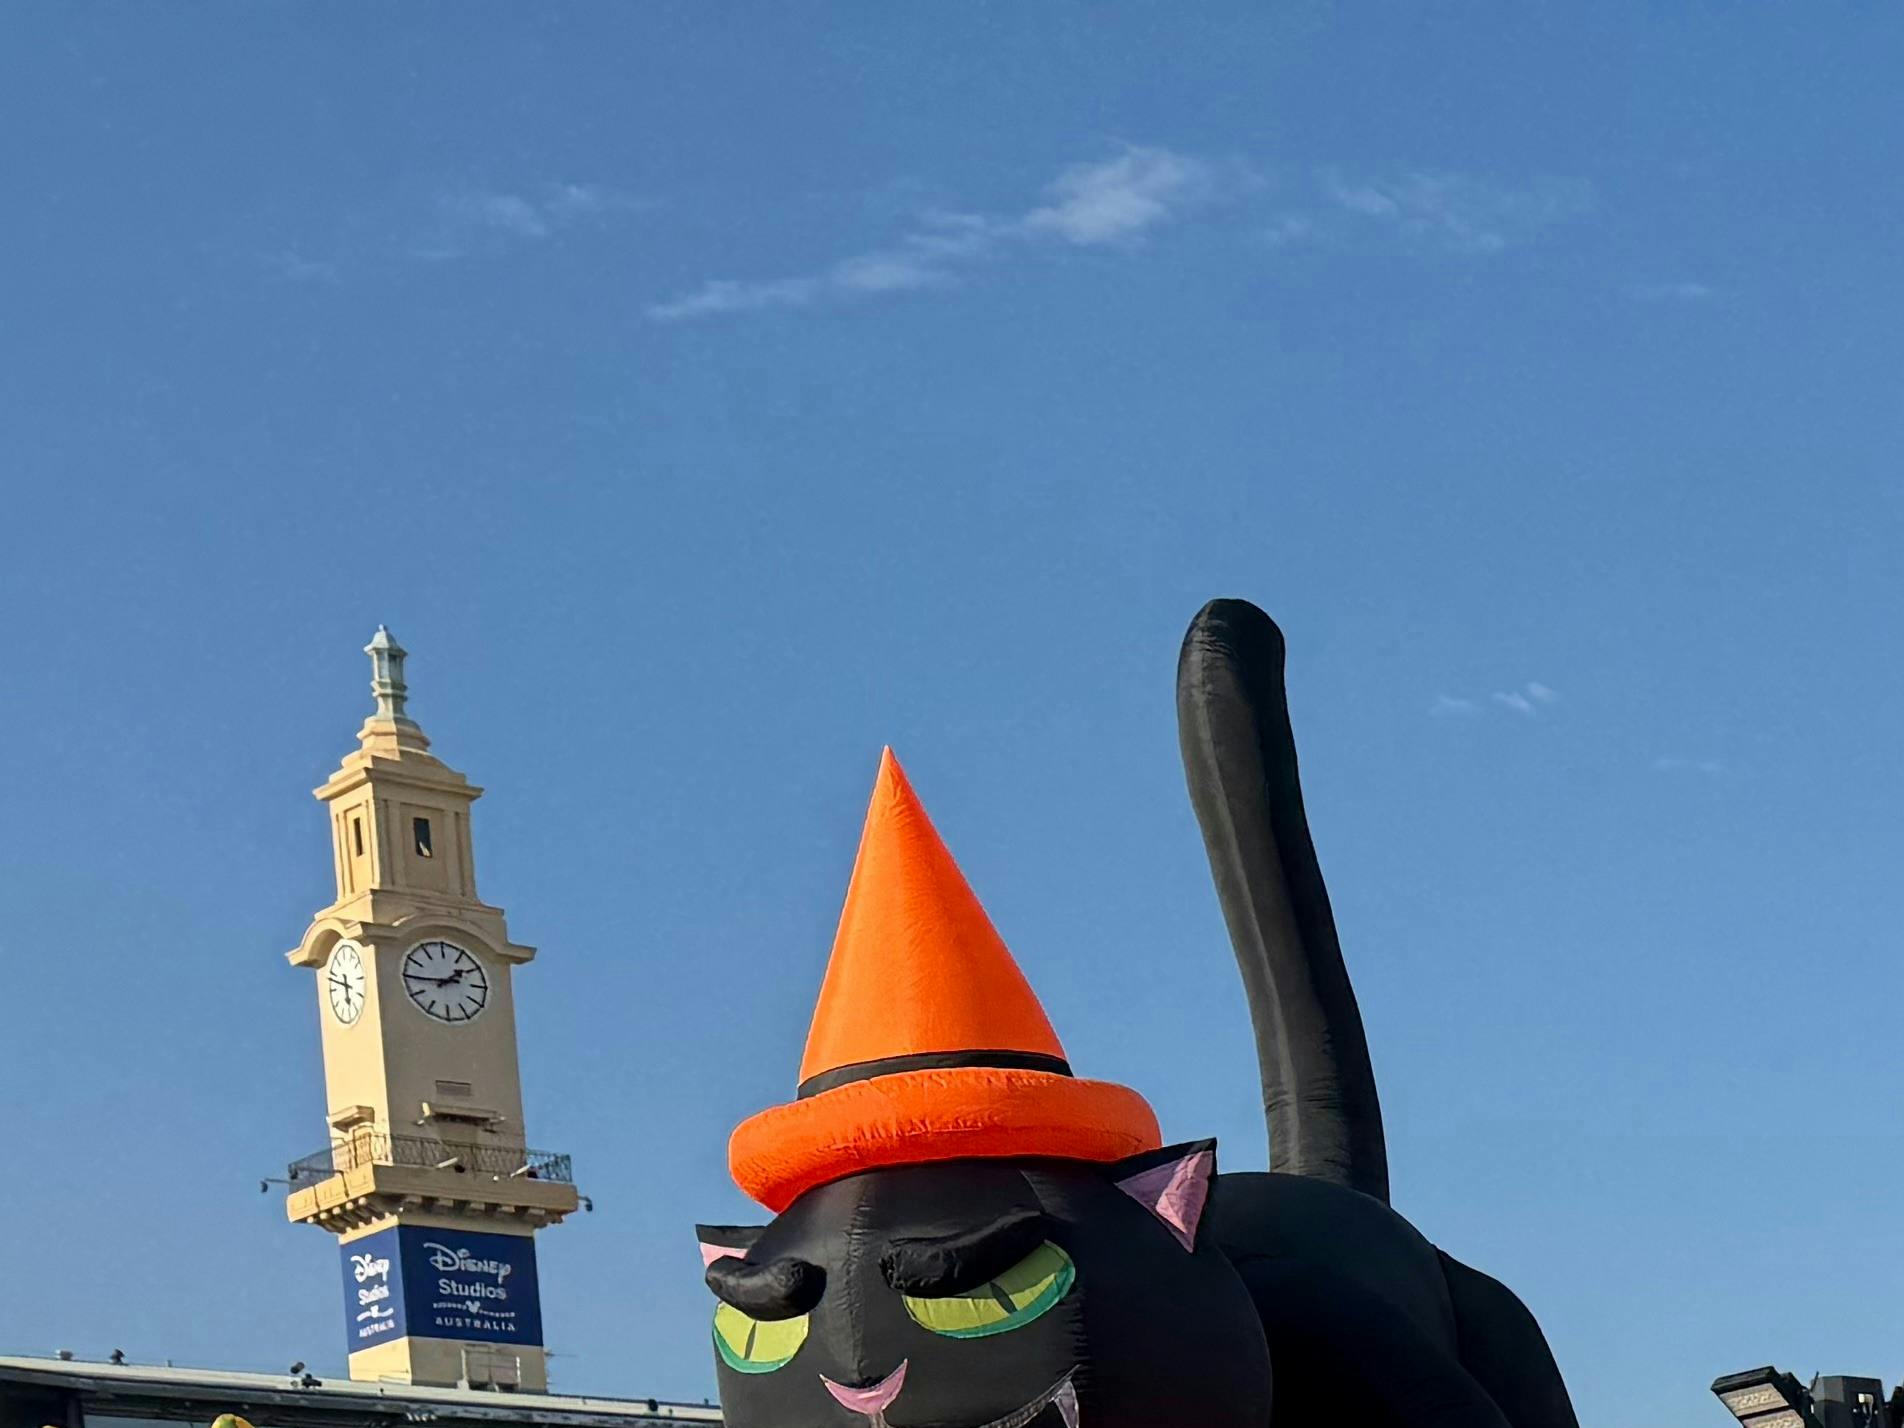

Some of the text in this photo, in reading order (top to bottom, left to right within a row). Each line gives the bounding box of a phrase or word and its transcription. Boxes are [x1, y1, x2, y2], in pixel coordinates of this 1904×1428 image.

[423, 1242, 512, 1284] Disney
[438, 1278, 507, 1300] Studios
[435, 1316, 516, 1332] AUSTRALIA
